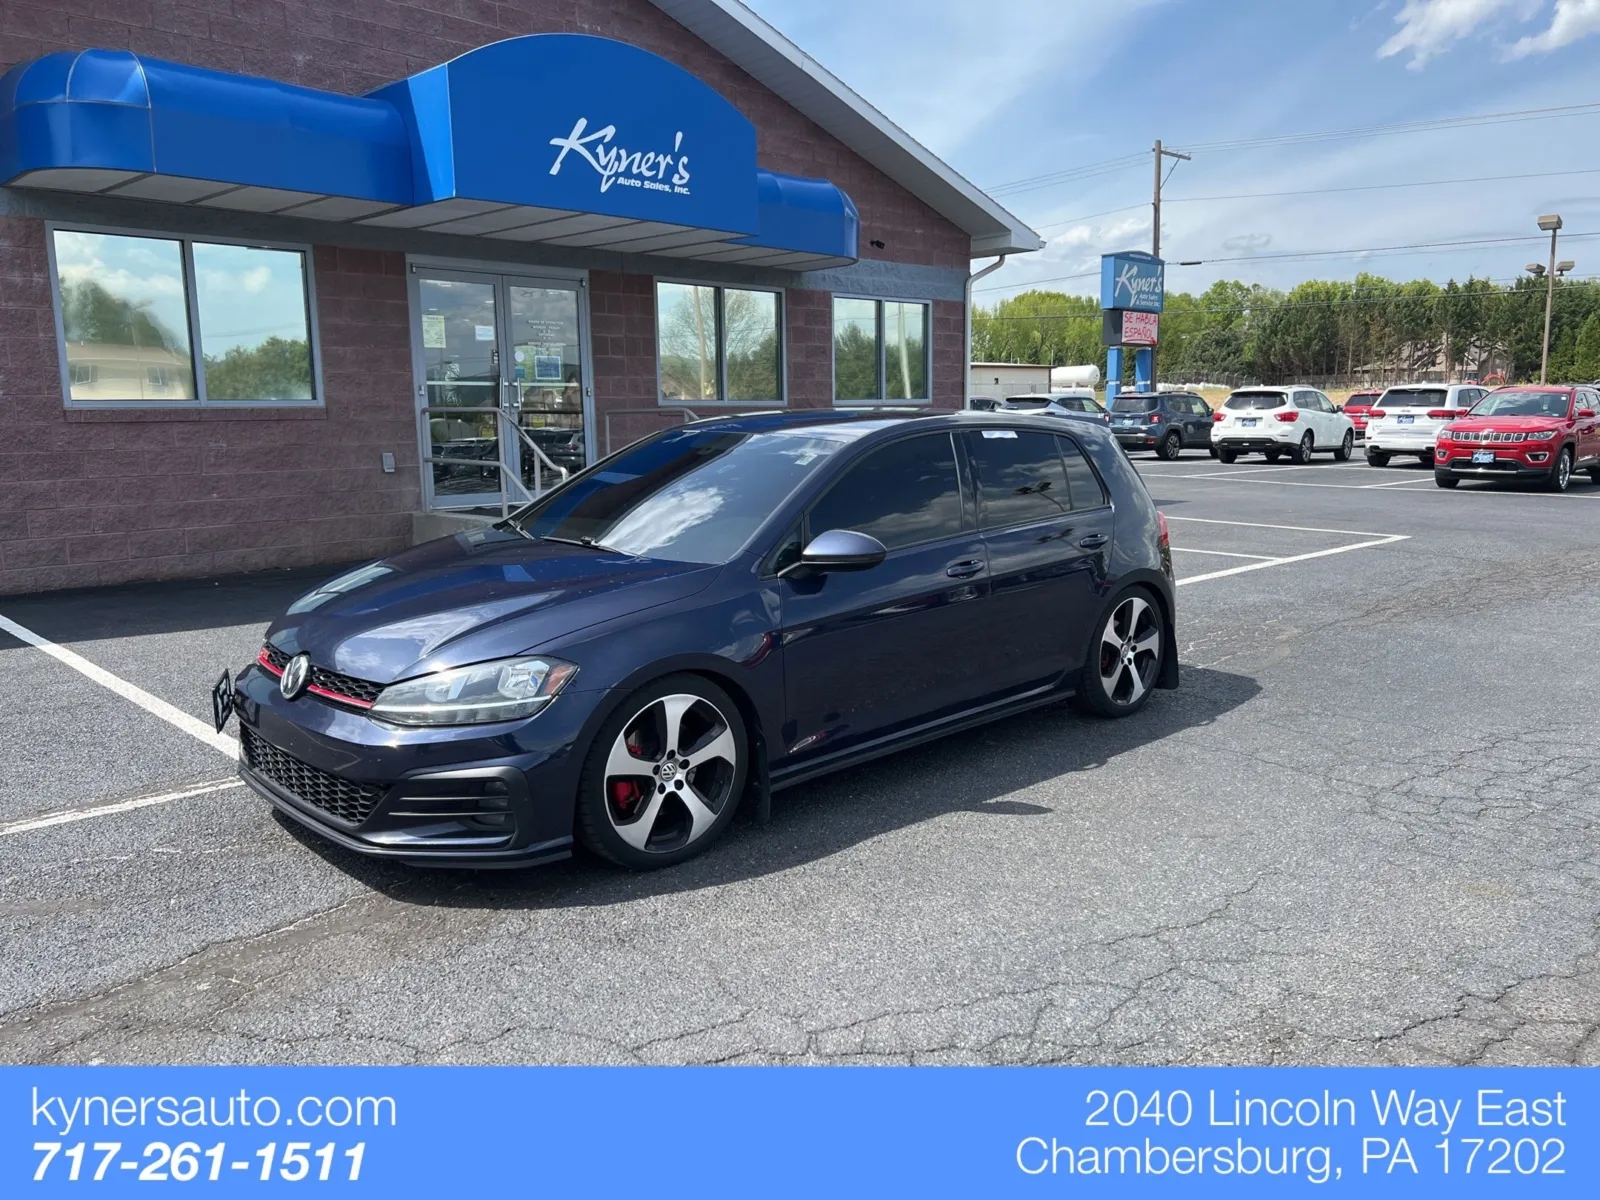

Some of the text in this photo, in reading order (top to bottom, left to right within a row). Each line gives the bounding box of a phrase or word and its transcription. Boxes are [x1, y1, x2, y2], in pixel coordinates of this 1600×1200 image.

[549, 117, 690, 193] Kyner's
[617, 176, 690, 195] Auto Sales, Inc.
[1115, 263, 1162, 307] Kyner's
[1124, 312, 1158, 326] SE HABLA
[1124, 326, 1154, 339] ESPAÑOL
